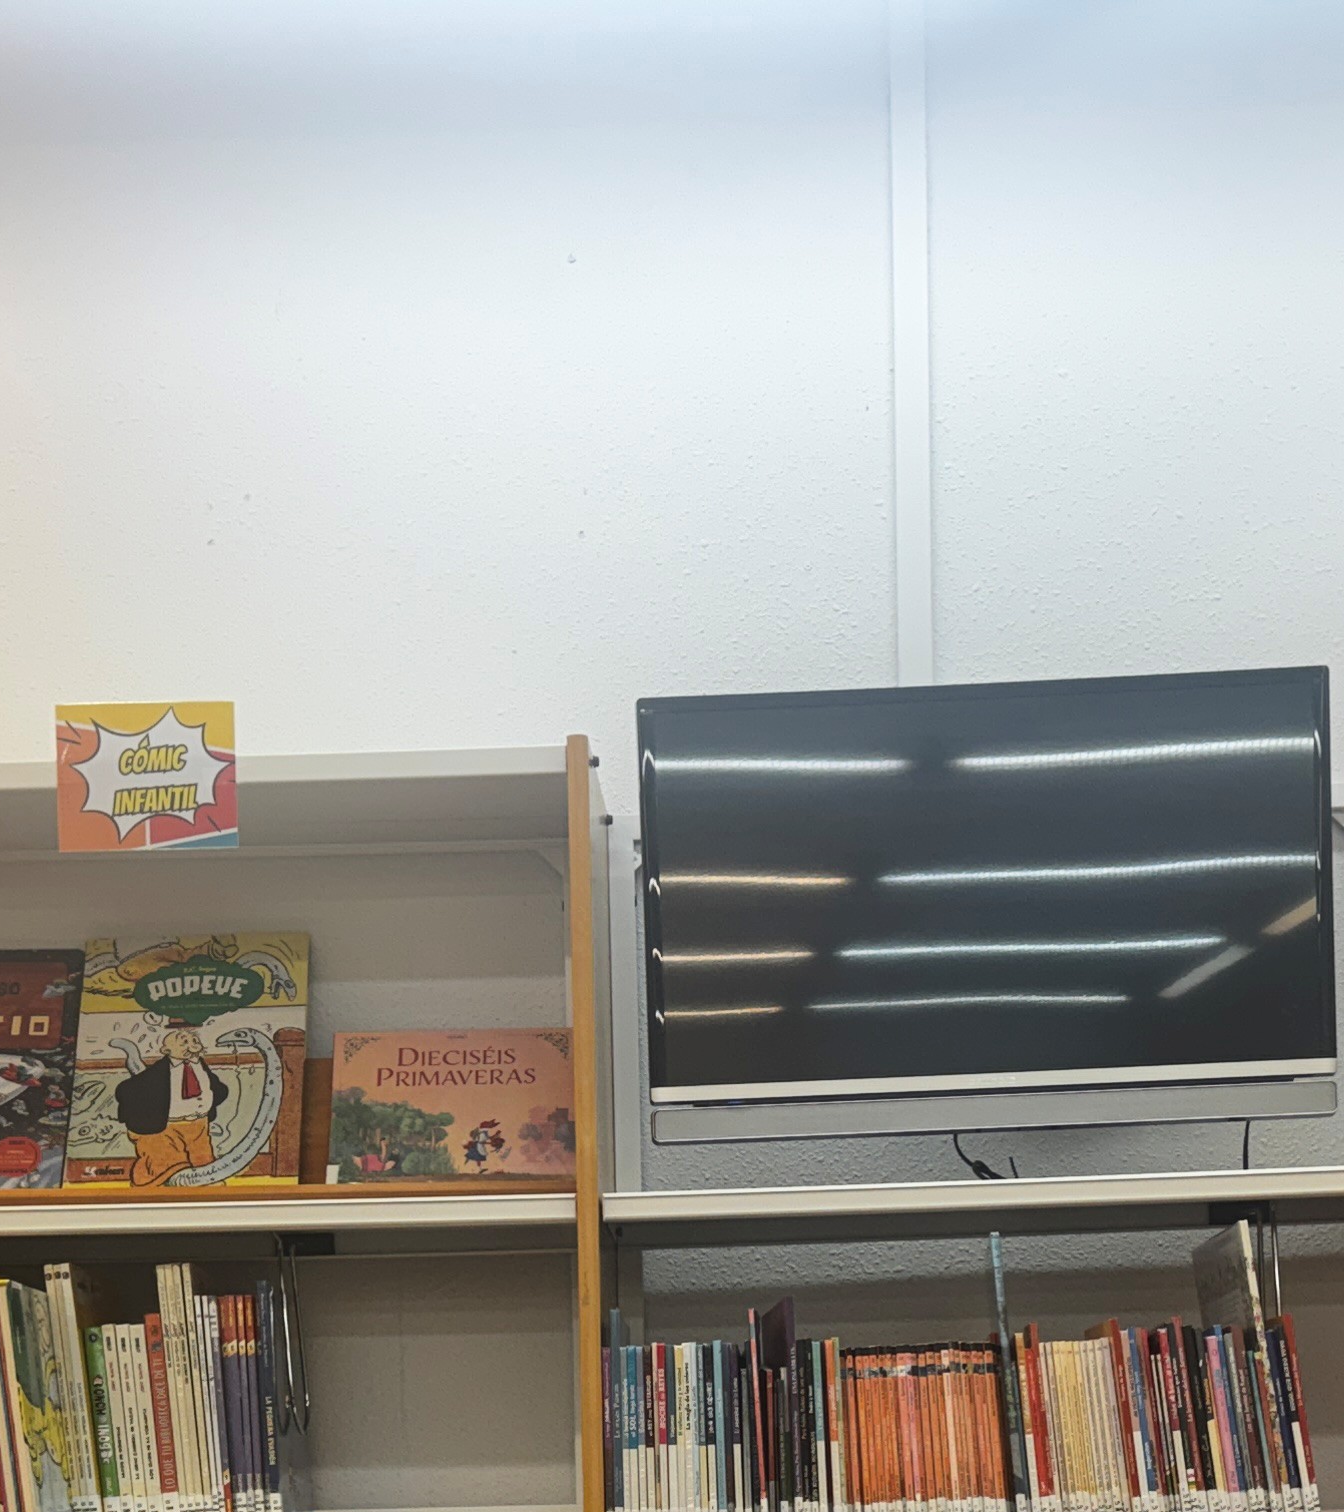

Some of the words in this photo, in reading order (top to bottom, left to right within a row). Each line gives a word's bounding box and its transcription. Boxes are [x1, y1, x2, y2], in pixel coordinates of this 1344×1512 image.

[119, 733, 188, 776] CÓMIC
[112, 783, 199, 817] INFANTIL
[147, 974, 249, 1002] POPEYE
[397, 1045, 517, 1067] DIECISÉIS
[376, 1066, 536, 1087] PRIMAVERAS
[159, 1400, 172, 1445] BIBLIOTECA
